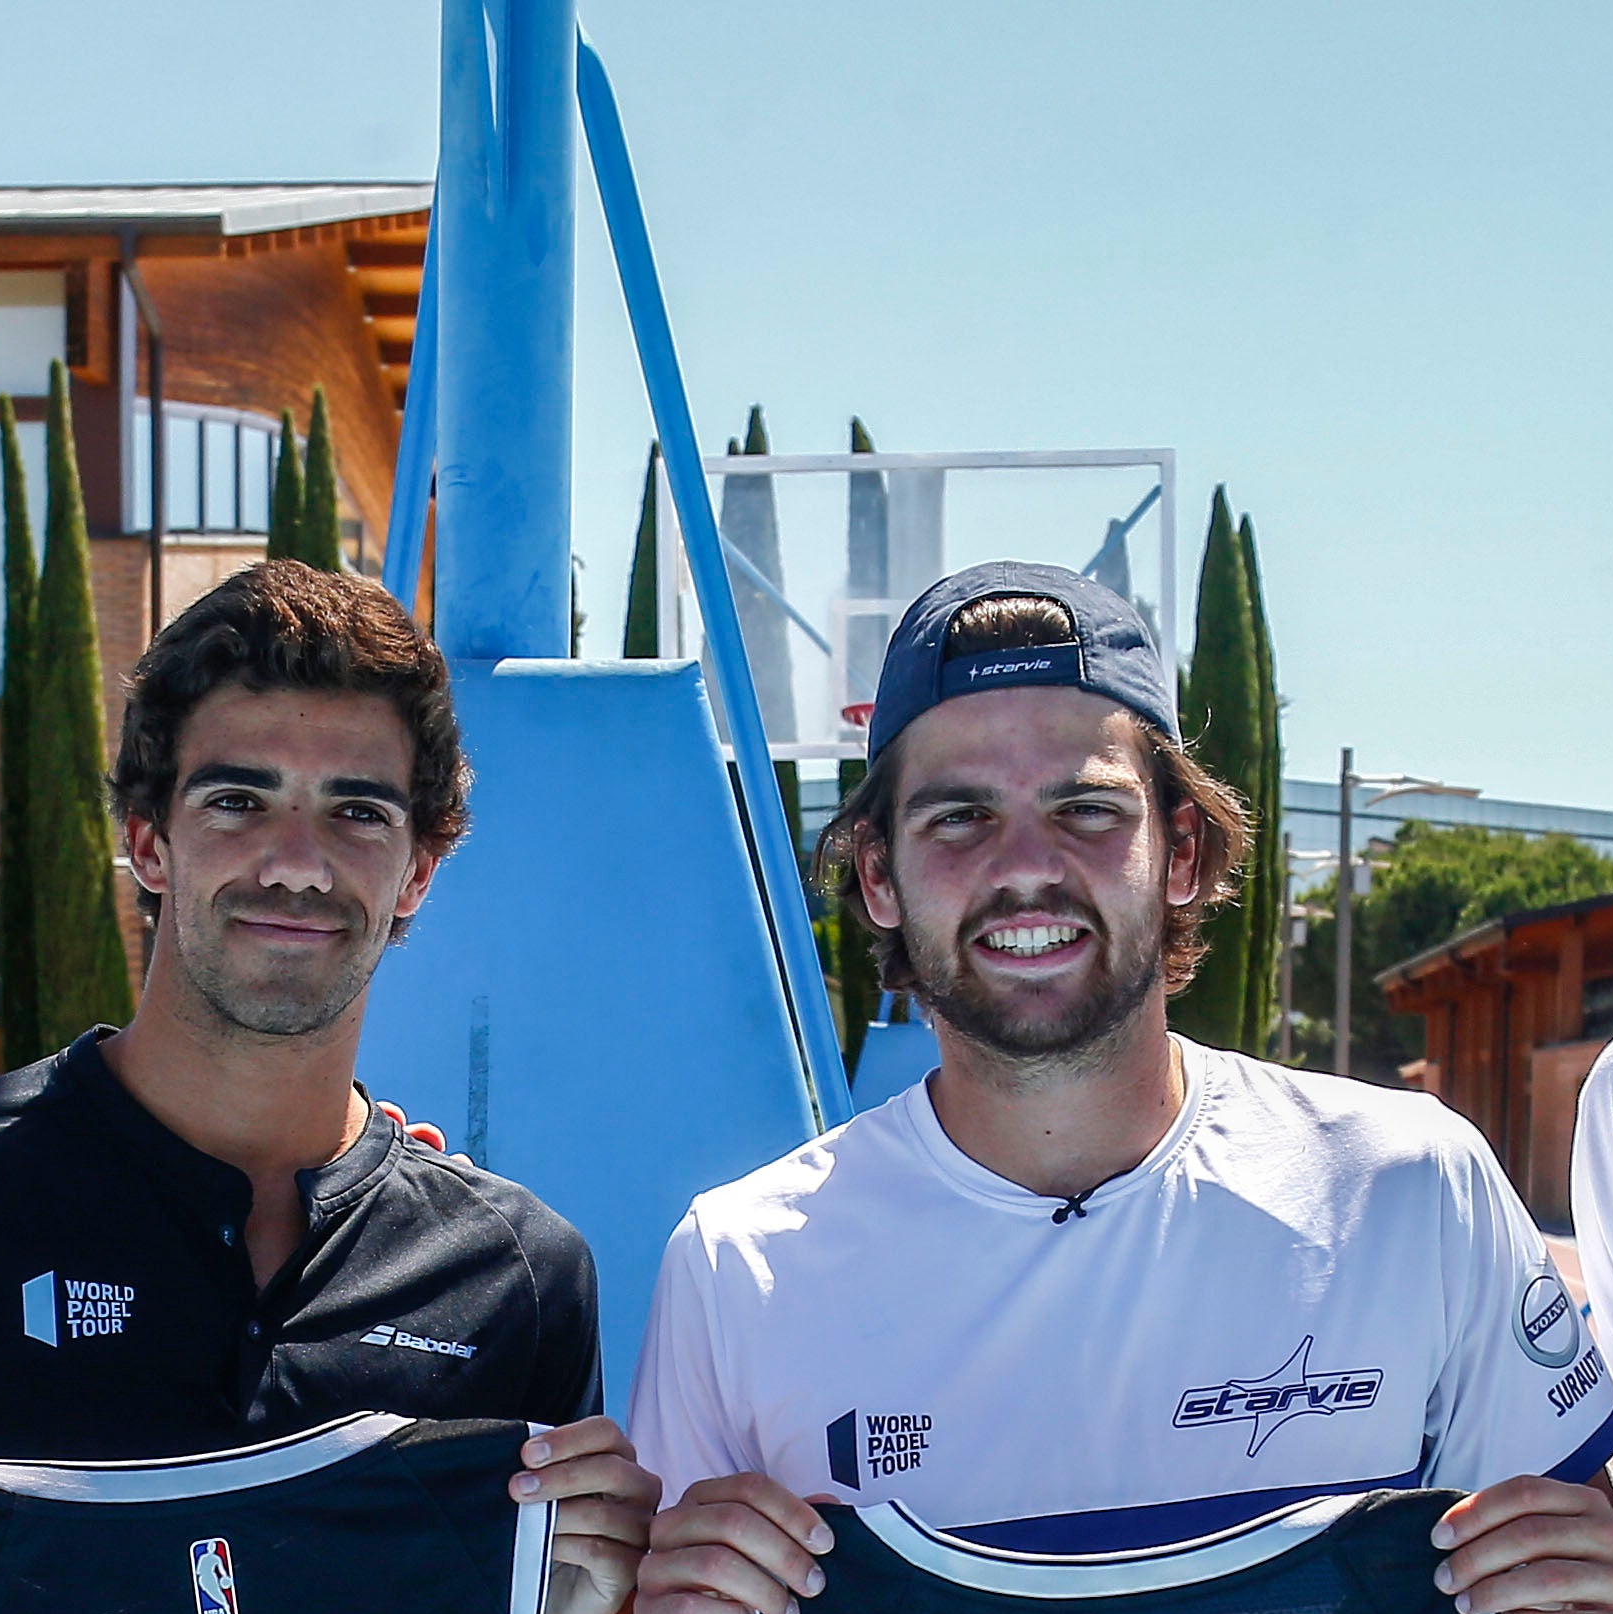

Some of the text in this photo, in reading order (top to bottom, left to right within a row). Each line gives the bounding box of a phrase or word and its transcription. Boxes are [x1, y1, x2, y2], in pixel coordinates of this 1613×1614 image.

[65, 1279, 135, 1302] WORLD
[67, 1300, 132, 1318] PADEL
[1527, 1297, 1567, 1337] VOLVO
[67, 1318, 123, 1339] TOUR
[1179, 1375, 1377, 1421] starvie
[866, 1415, 932, 1435] WORLD
[867, 1432, 929, 1458] PADEL
[867, 1451, 921, 1479] TOUR
